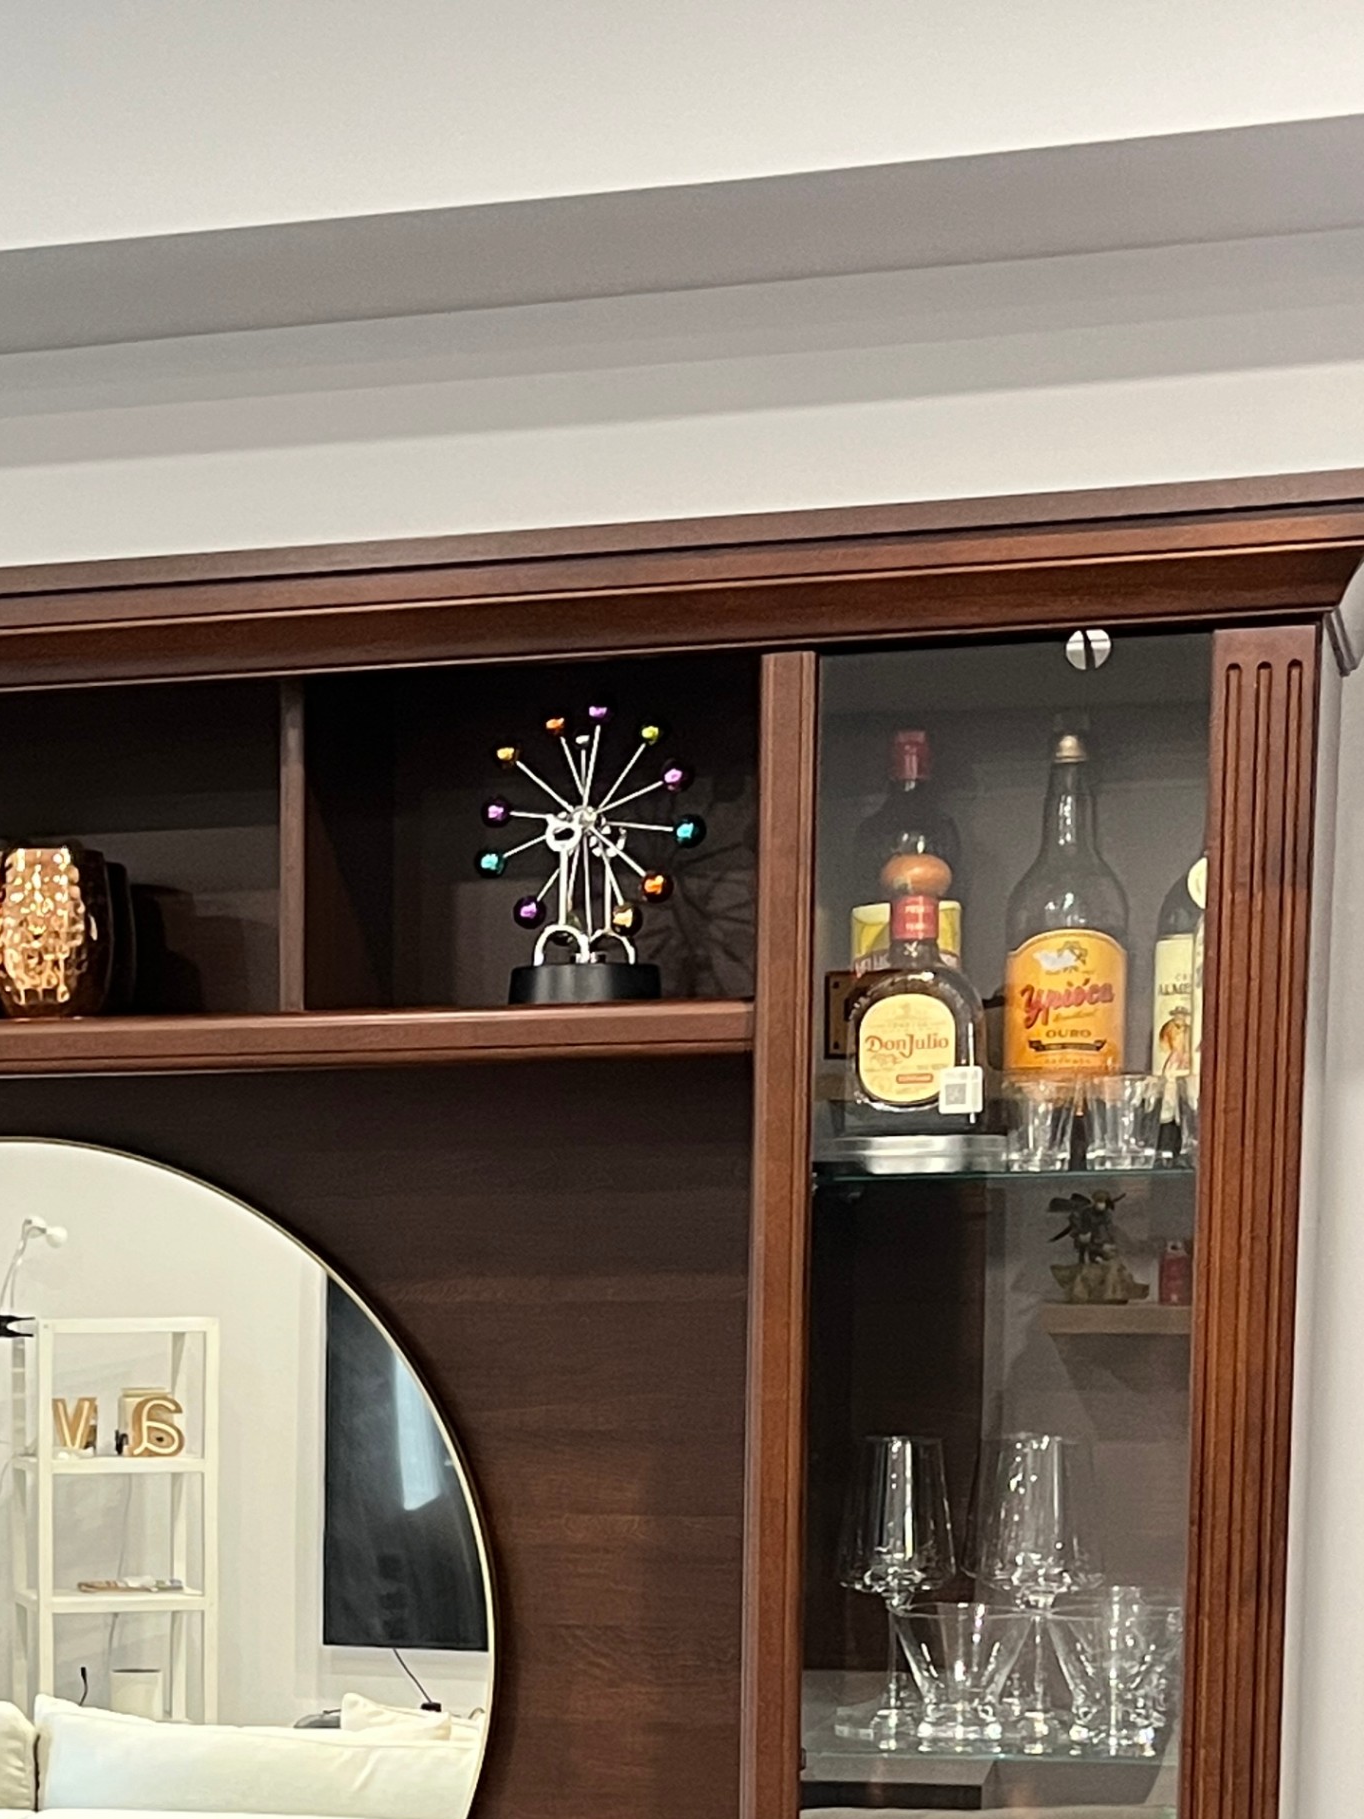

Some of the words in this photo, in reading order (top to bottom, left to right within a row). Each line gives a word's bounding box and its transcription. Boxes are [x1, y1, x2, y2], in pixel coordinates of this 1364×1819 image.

[1045, 1029, 1092, 1040] OURO
[864, 1035, 906, 1053] Don
[899, 1032, 949, 1059] Julio
